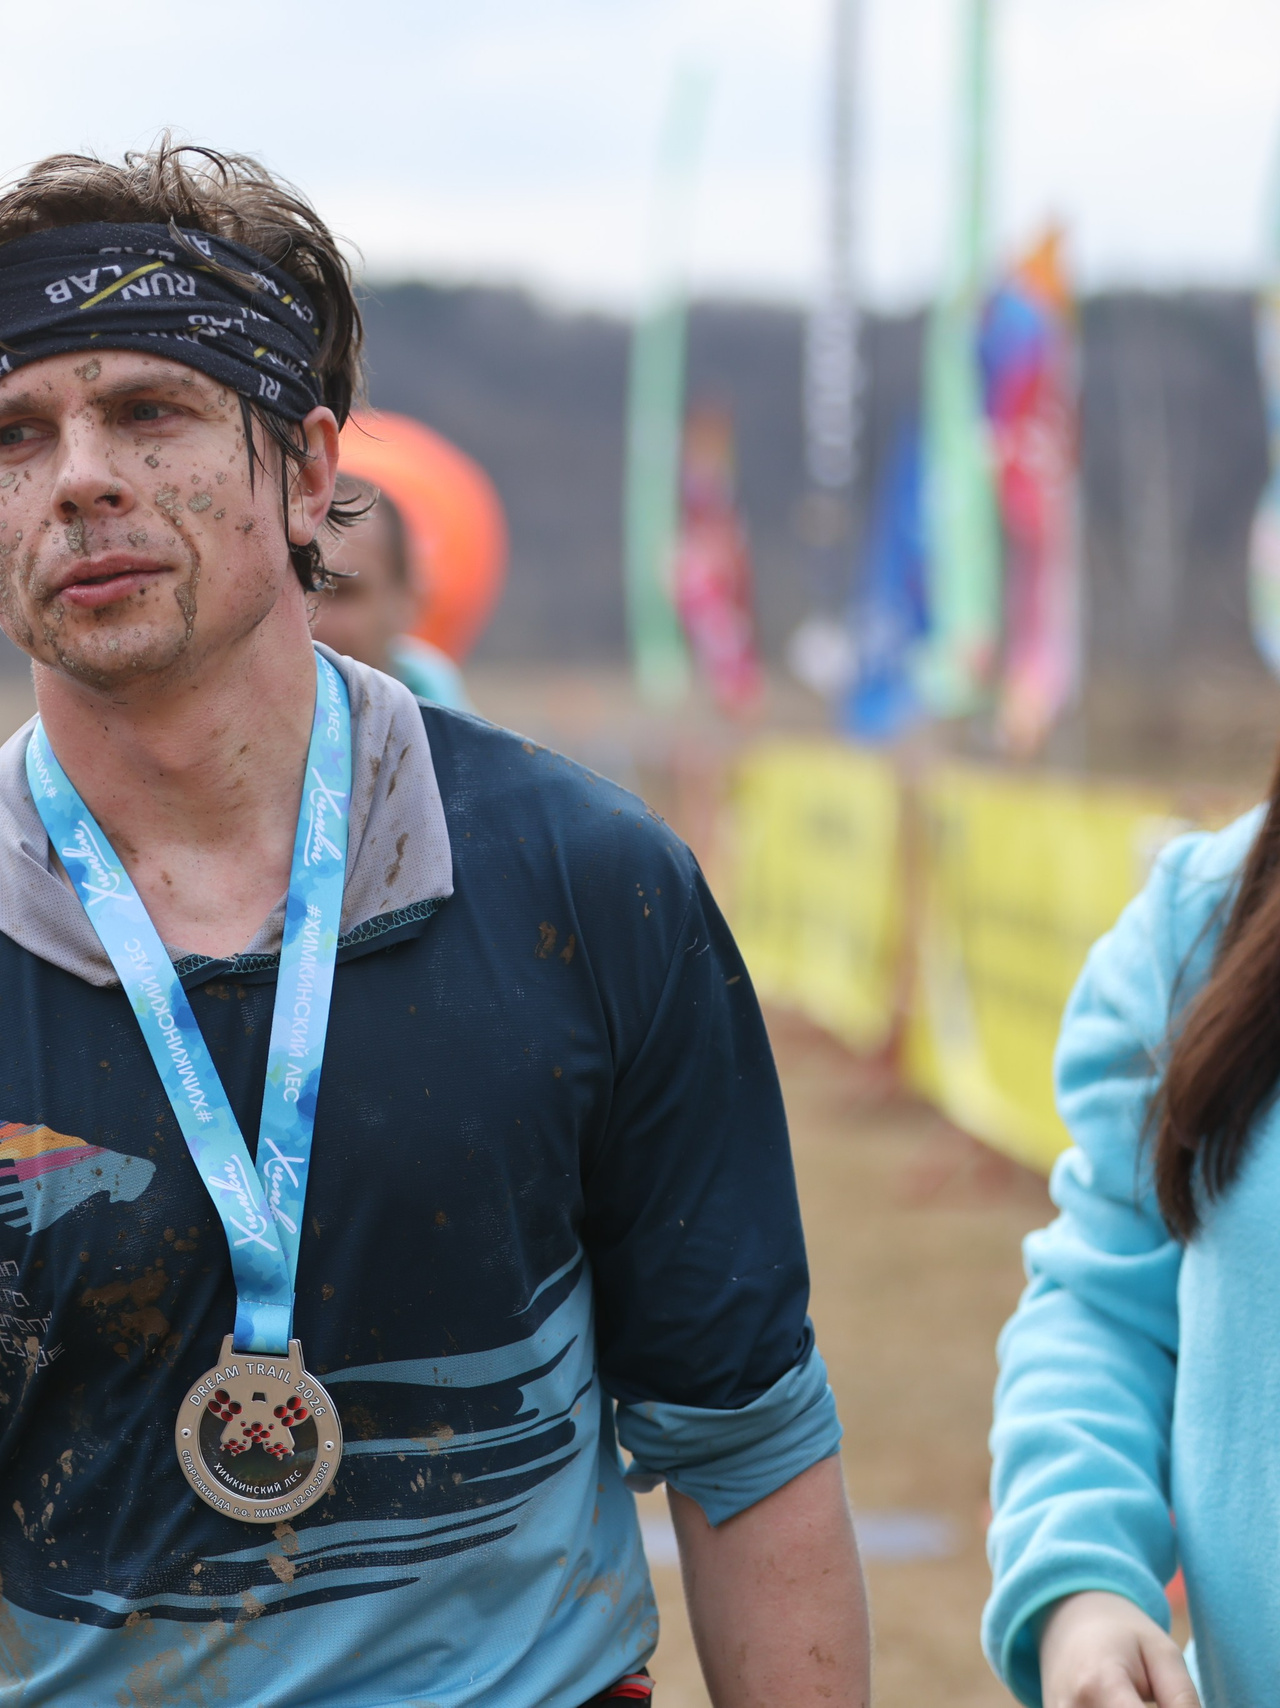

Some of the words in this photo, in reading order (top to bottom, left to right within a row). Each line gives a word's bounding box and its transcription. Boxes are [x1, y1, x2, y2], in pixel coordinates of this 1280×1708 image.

[44, 264, 123, 304] LAB
[121, 271, 197, 301] RUN
[326, 703, 341, 742] ЛЕС
[304, 766, 346, 866] Химки
[61, 819, 134, 907] Химки
[124, 938, 153, 972] ЛЕС
[288, 903, 323, 1058] #ХИМКИНСКИЙ
[139, 973, 214, 1124] #ХИМКИНСКИЙ
[283, 1063, 300, 1104] ЛЕС
[207, 1154, 278, 1252] Химки
[189, 1364, 240, 1407] DREAM
[245, 1362, 292, 1385] TRAIL
[294, 1380, 327, 1417] 2026
[181, 1449, 231, 1512] СПАРТАКИАДА
[254, 1503, 293, 1519] ХИМКИ
[293, 1461, 331, 1507] 12.04.2026
[213, 1463, 282, 1495] ХИМКИНСКИЙ
[284, 1469, 303, 1488] ЛЕС
